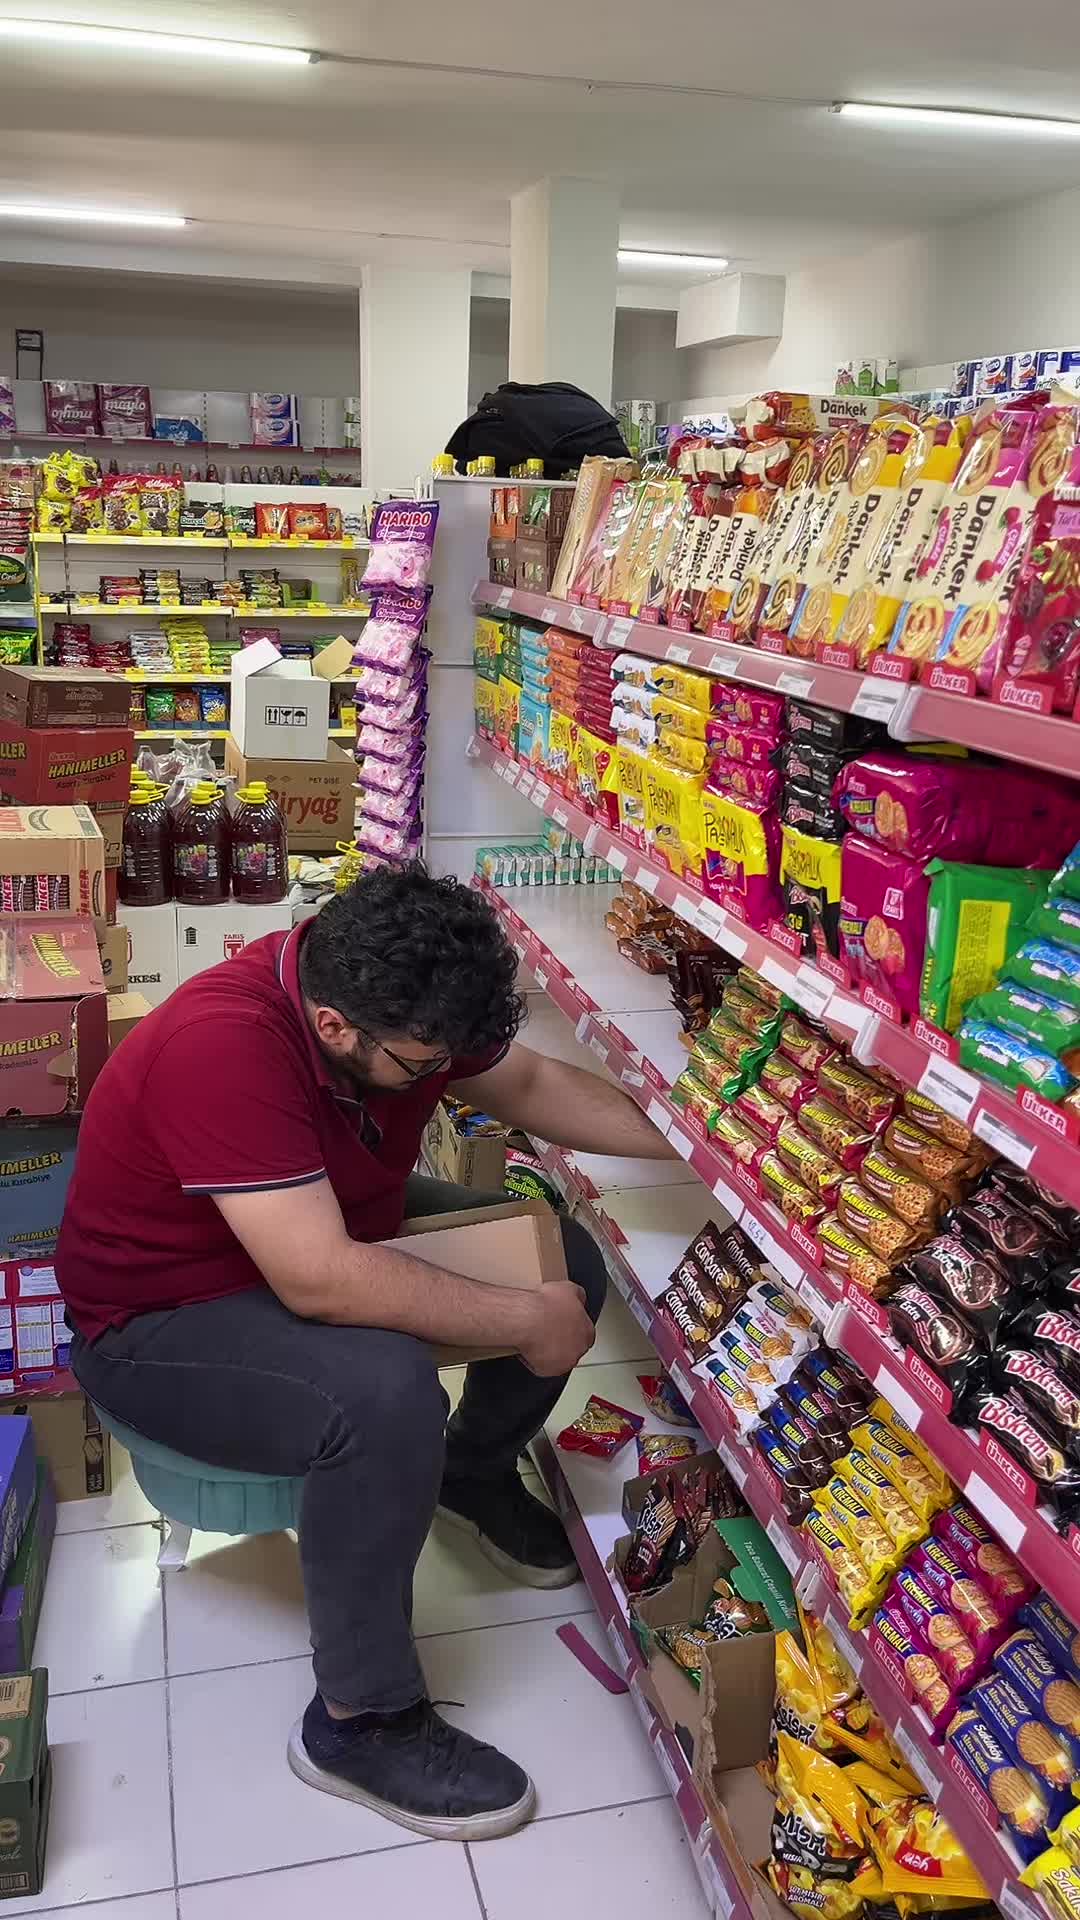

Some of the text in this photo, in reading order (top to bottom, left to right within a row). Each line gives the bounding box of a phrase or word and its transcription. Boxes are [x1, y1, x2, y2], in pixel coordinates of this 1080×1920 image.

[821, 399, 867, 417] Dankek
[378, 510, 433, 527] HARIBO
[730, 529, 758, 581] Dankek
[833, 494, 882, 585] Dankek
[944, 495, 997, 602] Dankek
[822, 647, 850, 667] ÜLKER
[872, 655, 903, 679] ÜLKER
[929, 667, 969, 693] ÜLKER
[1000, 682, 1042, 711] ÜLKER
[48, 748, 127, 779] HANIMELLER
[772, 925, 796, 950] ÜLKER
[820, 953, 844, 981] ÜLKER
[865, 987, 894, 1018] ÜLKER
[915, 1020, 950, 1056] ÜLKER
[1021, 1092, 1067, 1137] ÜLKER
[512, 1152, 534, 1166] SÜPER
[735, 1164, 758, 1194] ÜLKER
[975, 1203, 996, 1219] Extra
[790, 1224, 817, 1260] ÜLKER
[931, 1247, 955, 1271] Extra
[848, 1284, 881, 1323] ÜLKER
[899, 1299, 921, 1321] Extra
[911, 1356, 944, 1403] ÜLKER
[1004, 1349, 1077, 1409] Biskrem
[872, 1425, 906, 1456] KREMALI
[978, 1396, 1051, 1462] Biskrem
[852, 1455, 886, 1487] KREMALI
[986, 1439, 1027, 1495] ÜLKER
[831, 1486, 866, 1517] KREMALI
[809, 1516, 838, 1550] KREMALI
[952, 1505, 991, 1540] KREMALI
[924, 1541, 964, 1579] KREMALI
[902, 1576, 938, 1614] KREMALI
[877, 1615, 911, 1654] KREMALI
[874, 1637, 906, 1692] ÜLKER
[974, 1723, 1004, 1763] Saklıköy
[951, 1753, 990, 1818] ÜLKER
[788, 1894, 825, 1908] AROMALI
